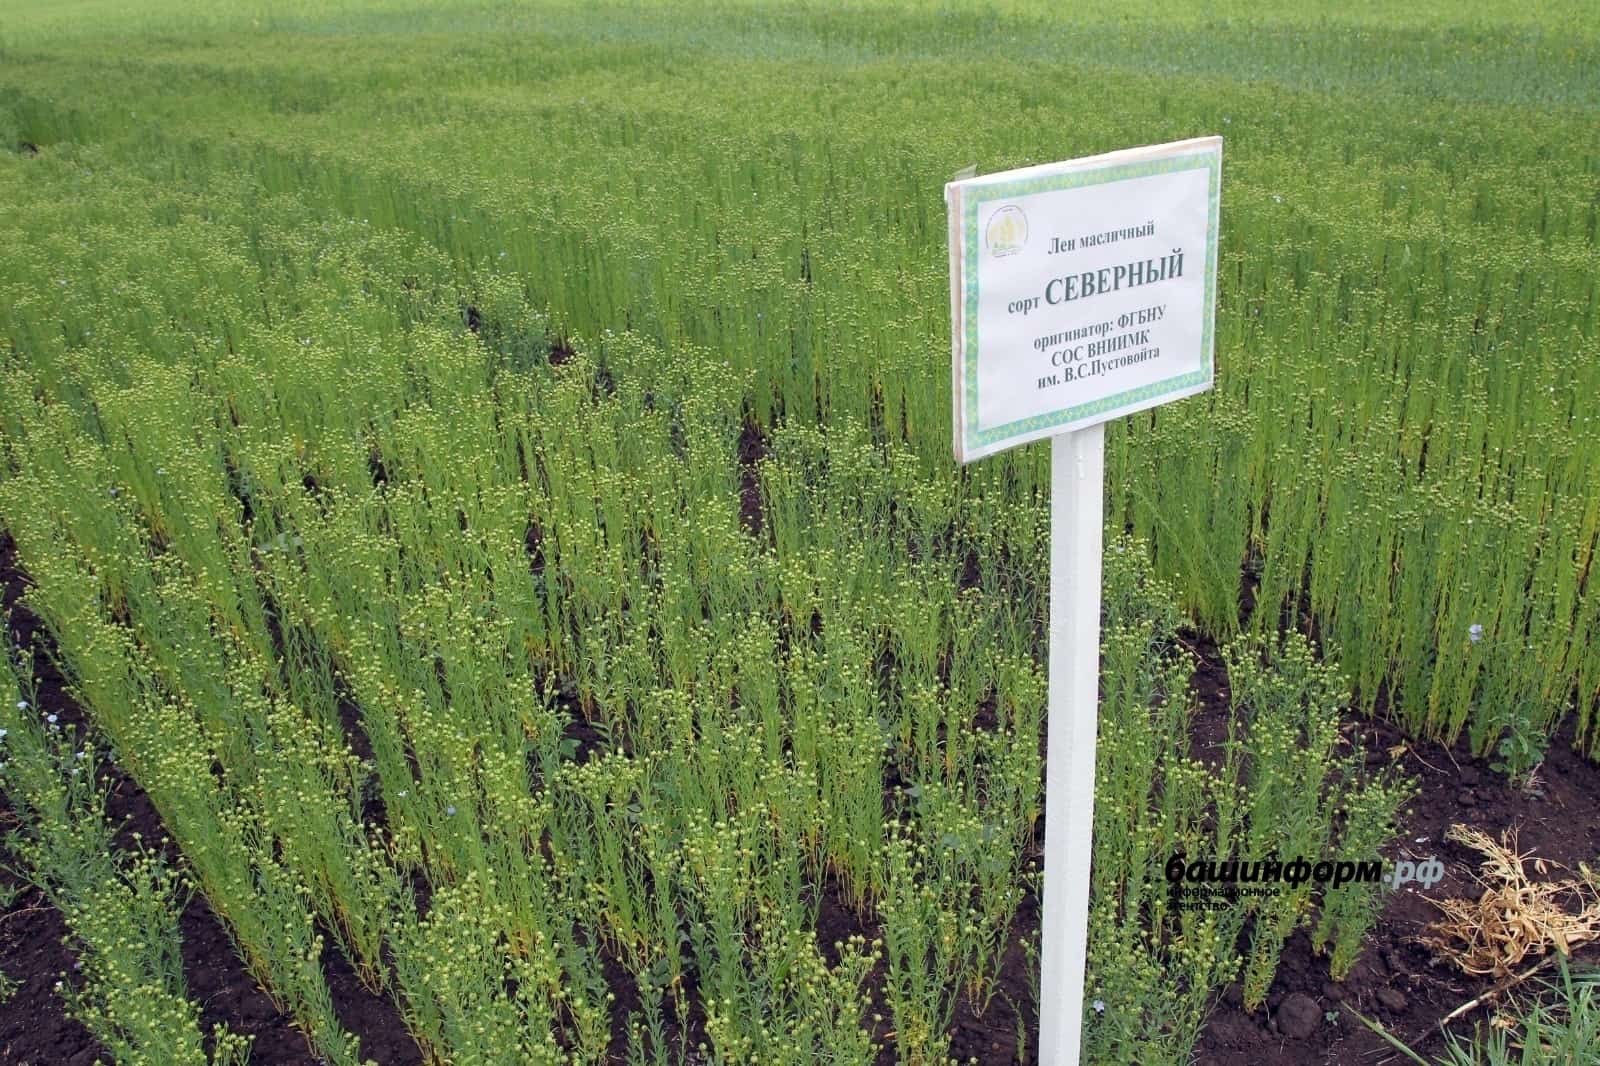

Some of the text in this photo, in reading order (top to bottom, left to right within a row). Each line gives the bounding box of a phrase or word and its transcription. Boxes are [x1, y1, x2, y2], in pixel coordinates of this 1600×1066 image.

[1048, 236, 1076, 254] Лен
[1080, 220, 1155, 249] масличный
[1008, 296, 1040, 316] сорт
[1045, 248, 1184, 306] СЕВЕРНЫЙ
[1034, 304, 1167, 351] оригинатор: ФГБНУ
[1051, 329, 1150, 368] СОС ВНИИМК
[1038, 347, 1160, 389] им. В.С.Пустовойта
